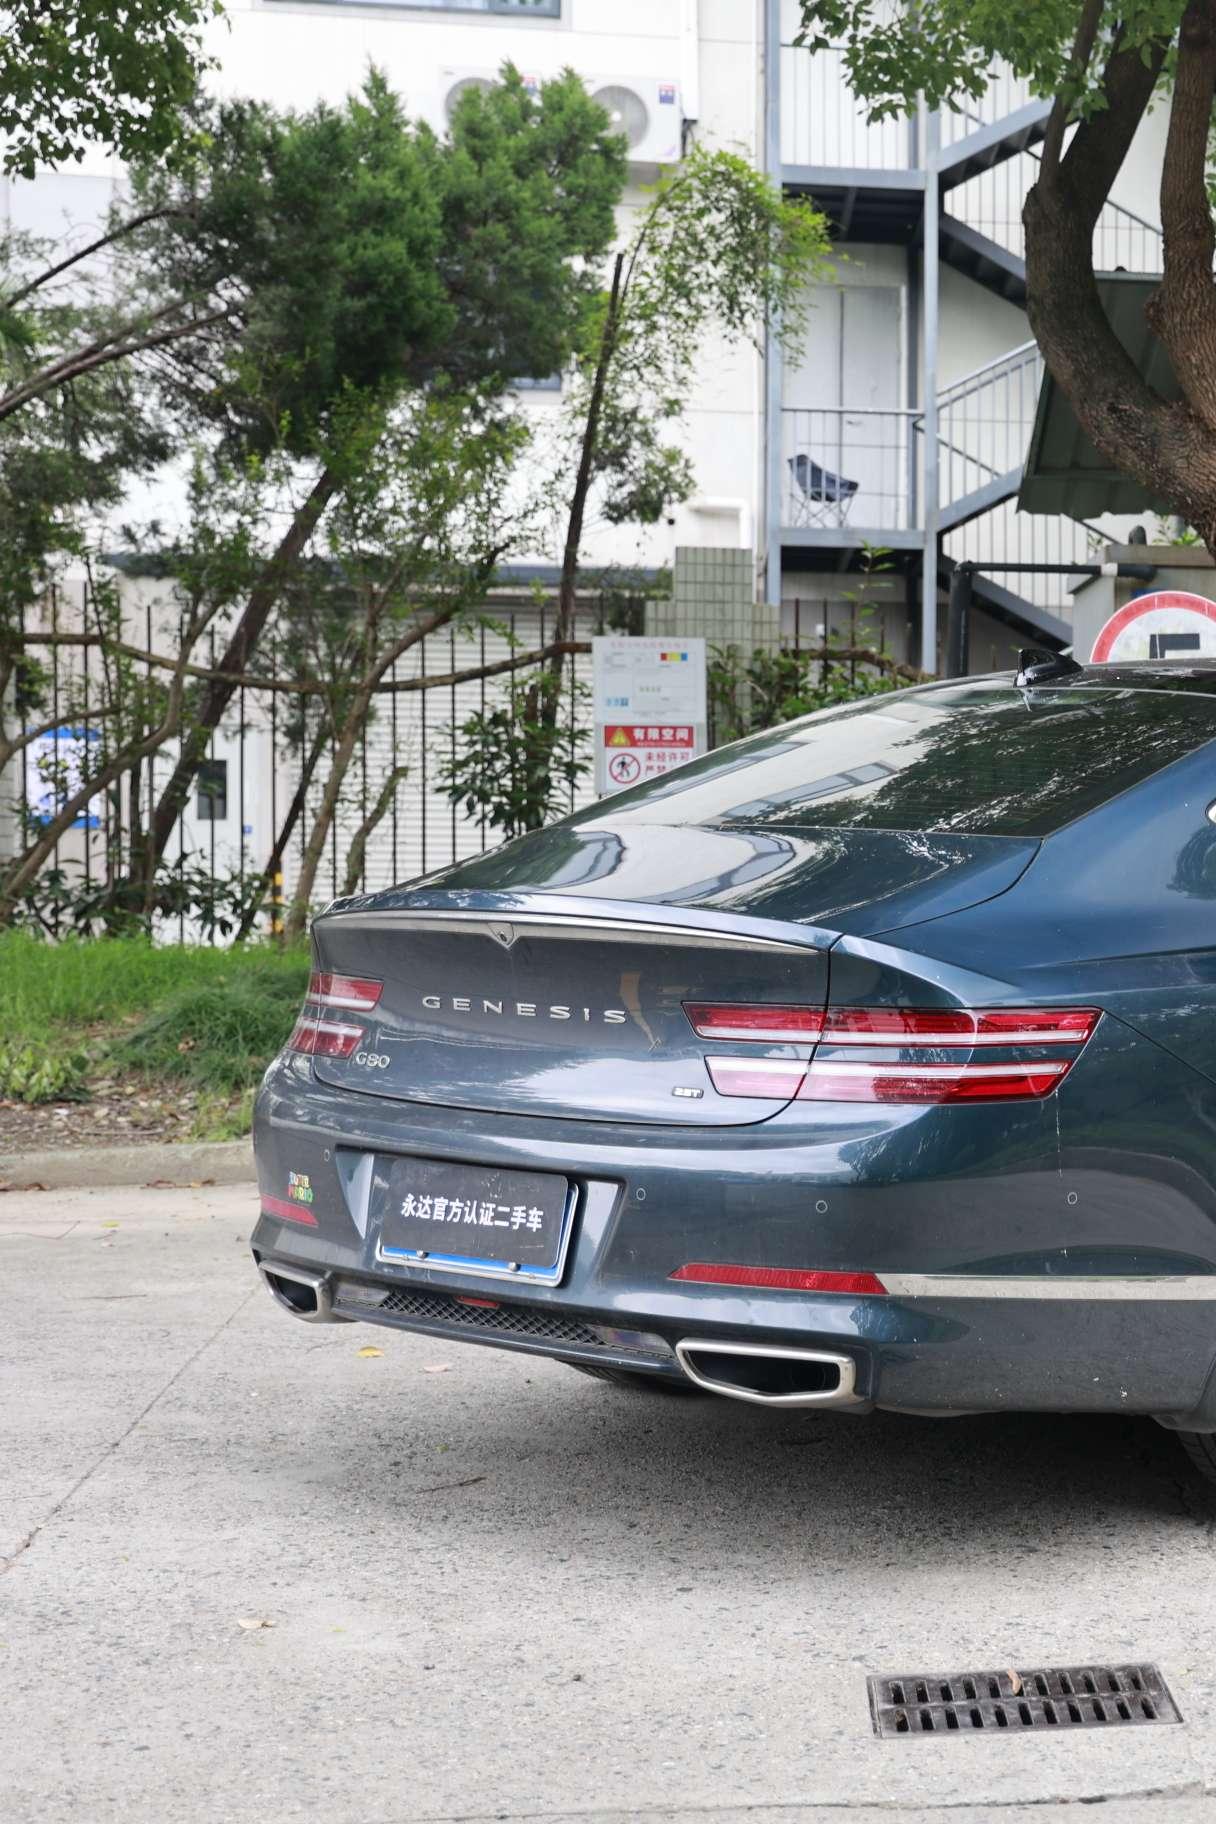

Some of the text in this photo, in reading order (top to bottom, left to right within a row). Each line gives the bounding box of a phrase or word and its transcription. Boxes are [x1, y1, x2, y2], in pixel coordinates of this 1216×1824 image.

[632, 727, 689, 741] 有限空间
[646, 752, 689, 762] 未经许可
[422, 996, 626, 1024] GENESIS
[355, 1052, 391, 1069] G80
[401, 1193, 544, 1232] 永达官方认证二手车
